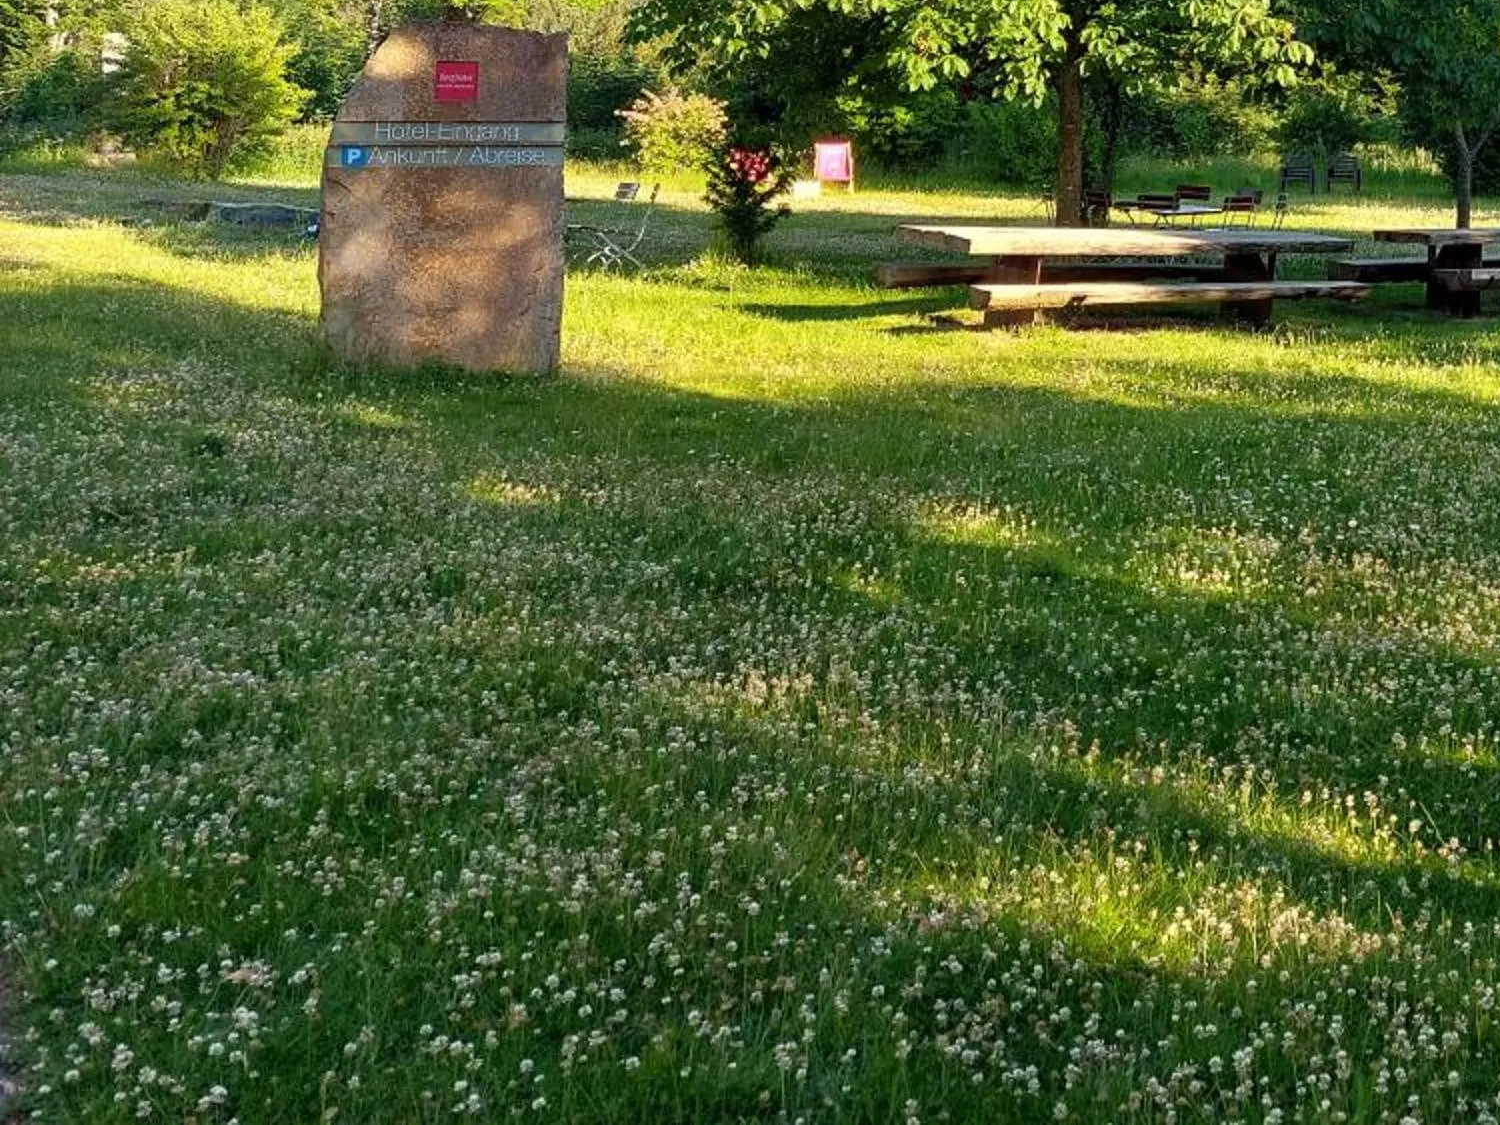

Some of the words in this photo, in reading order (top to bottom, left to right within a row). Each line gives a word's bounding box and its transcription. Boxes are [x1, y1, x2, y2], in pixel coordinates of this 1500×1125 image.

[375, 121, 519, 142] Hotel-Eingang
[347, 148, 361, 164] P
[367, 146, 448, 164] Ankunft
[469, 146, 545, 164] Abreise
